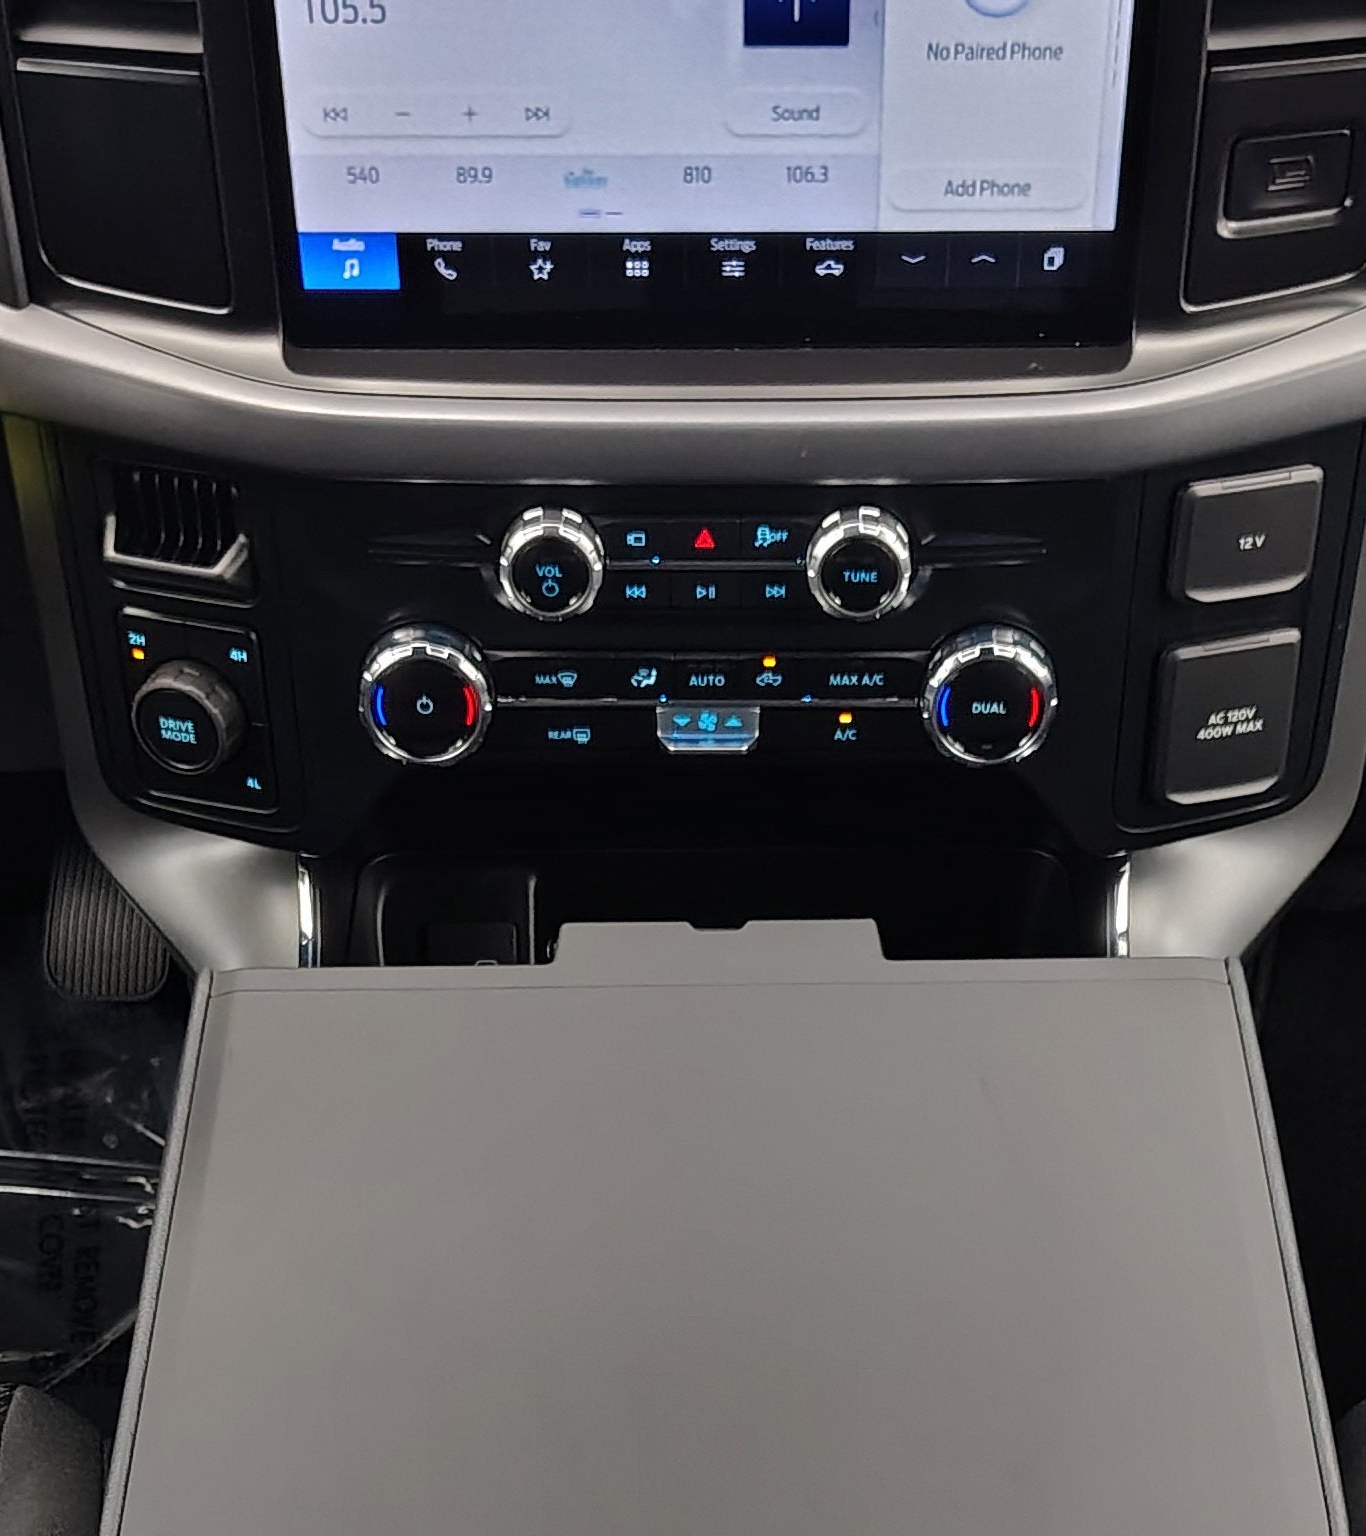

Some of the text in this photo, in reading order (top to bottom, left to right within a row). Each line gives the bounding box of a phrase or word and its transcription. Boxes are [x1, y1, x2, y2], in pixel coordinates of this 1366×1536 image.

[307, 0, 386, 24] 105.5
[926, 41, 1064, 61] No Paired Phone
[771, 105, 820, 122] Sound
[346, 166, 380, 185] 540
[456, 166, 493, 184] 89.9
[683, 166, 712, 185] 810
[786, 166, 830, 184] 106.3
[943, 179, 1032, 198] Add Phone
[426, 238, 463, 251] Phone
[530, 238, 552, 251] Fav
[622, 238, 652, 254] Apps
[710, 238, 757, 253] Settings
[806, 238, 854, 250] Features
[535, 565, 563, 578] VOL
[843, 570, 878, 583] TUNE
[128, 631, 146, 646] 2H
[230, 648, 247, 662] 4H
[688, 674, 725, 686] AUTO
[829, 673, 884, 686] MAX A/C
[972, 701, 1007, 716] DUAL
[1208, 705, 1257, 725] AC 120V
[159, 716, 195, 733] DRIVE
[1197, 718, 1264, 740] 400W MAX
[161, 729, 197, 744] MODE
[834, 728, 857, 741] A/C
[246, 777, 262, 790] 4L
